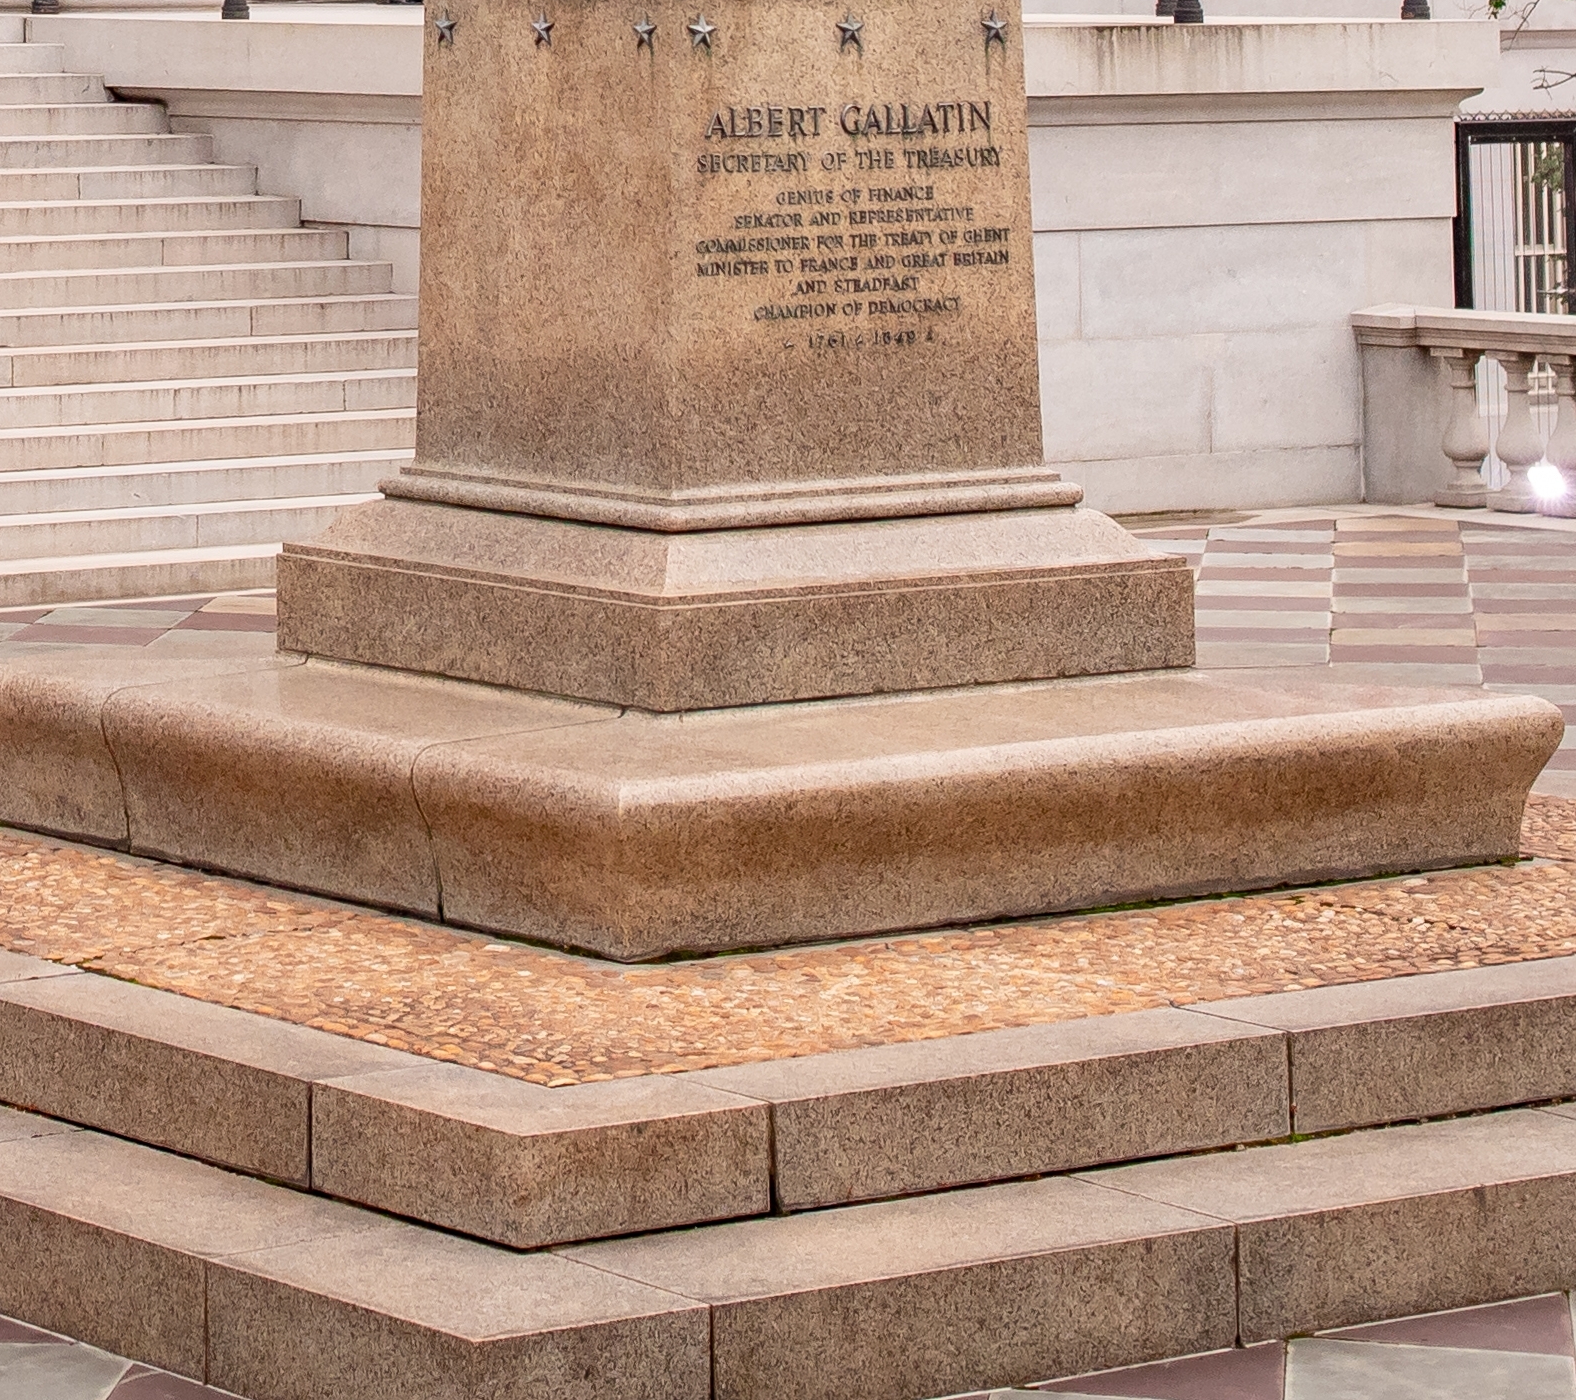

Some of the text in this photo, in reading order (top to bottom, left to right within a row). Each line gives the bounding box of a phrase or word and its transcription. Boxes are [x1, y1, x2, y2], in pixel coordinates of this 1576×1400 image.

[704, 100, 992, 139] ALBERT GALLATIN
[697, 146, 1001, 173] SECRETARY OF THE TREASURY
[776, 186, 934, 205] GENIUS OF FINANCE
[734, 207, 974, 228] SENATOR AND REPRESENTATIVE
[696, 228, 1010, 253] COMMISSIONER FOR THE TREATY OF GHENT
[697, 250, 1009, 277] MINISTER TO FRANCE AND GREAT BRITAIN
[794, 276, 919, 295] AND STEADFAST
[754, 297, 960, 321] CHAMPION OF DEMOCRACY
